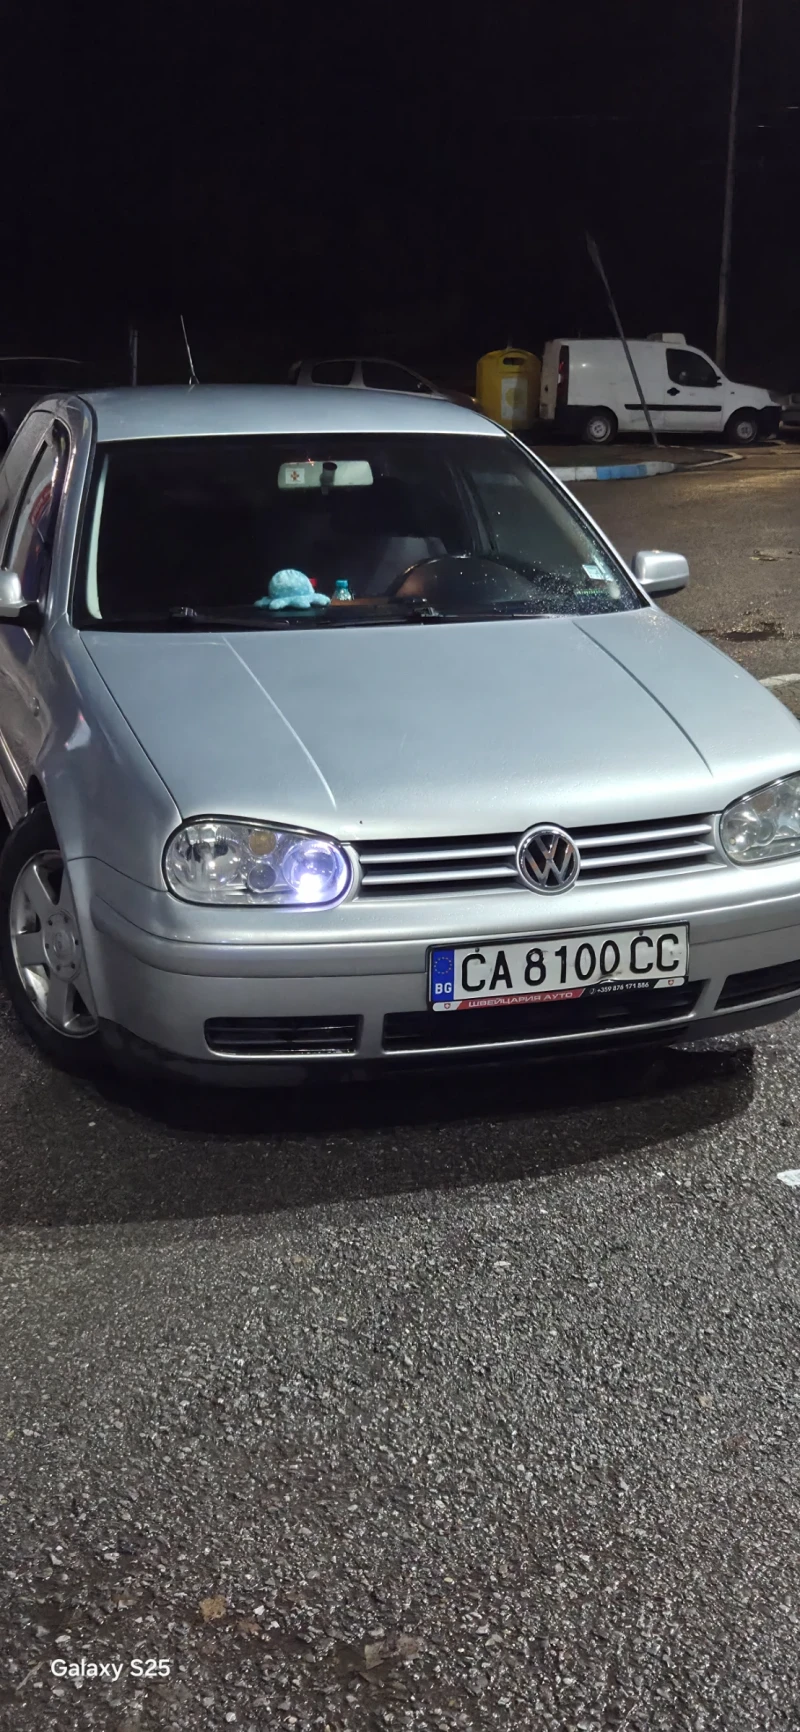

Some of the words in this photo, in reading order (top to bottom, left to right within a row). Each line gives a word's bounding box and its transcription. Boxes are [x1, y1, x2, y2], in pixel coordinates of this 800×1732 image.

[520, 831, 577, 888] VW
[461, 950, 513, 992] CA
[524, 940, 620, 986] 8100
[629, 934, 679, 974] CC
[435, 982, 452, 995] BG
[468, 995, 541, 1008] ШВЕЙЦАРИЯ
[543, 992, 573, 1001] АУТО
